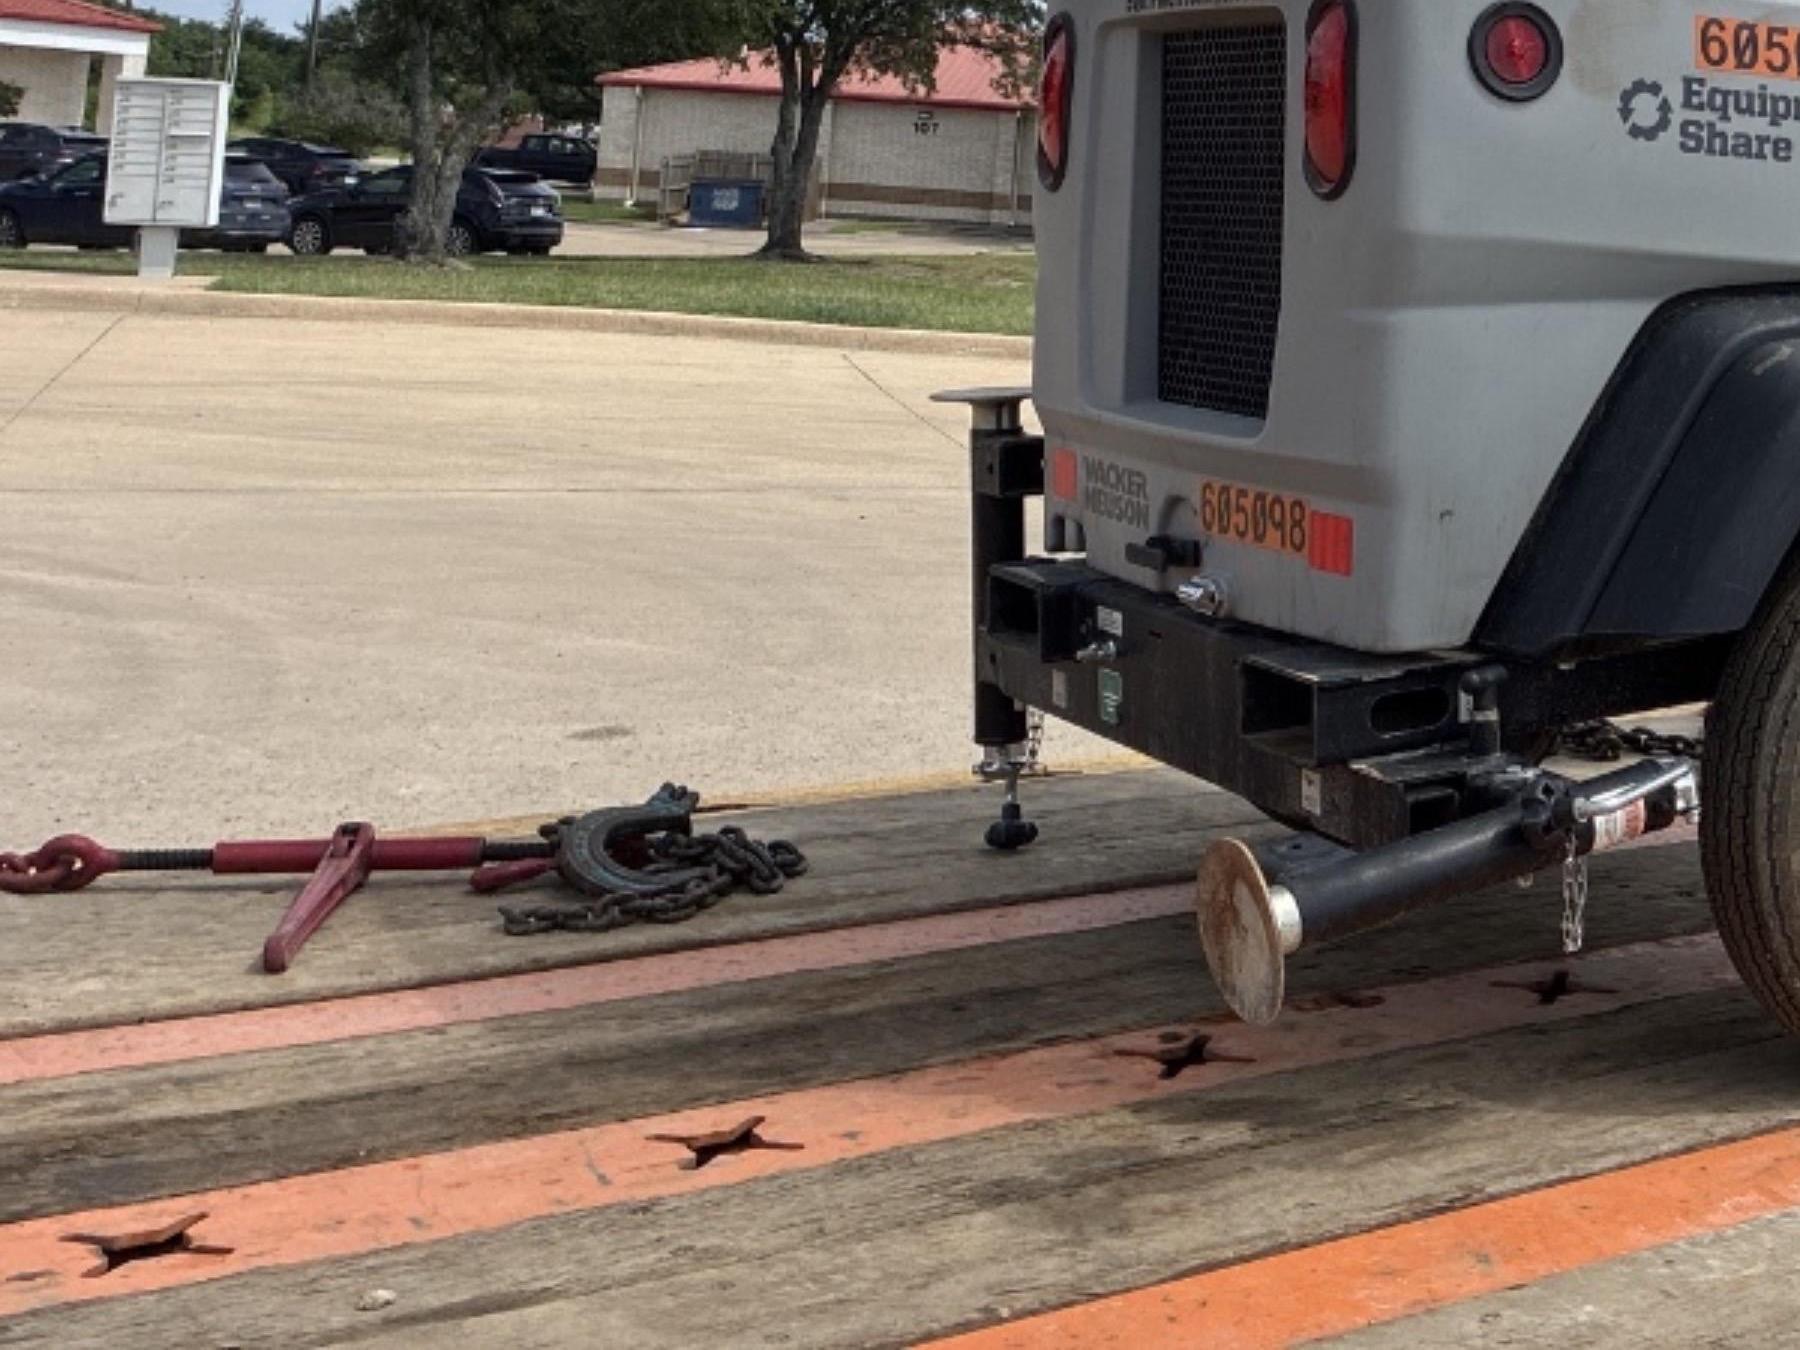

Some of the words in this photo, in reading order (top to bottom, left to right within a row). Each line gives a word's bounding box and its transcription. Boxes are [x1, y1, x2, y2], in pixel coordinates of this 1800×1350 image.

[1678, 118, 1794, 164] Share
[1082, 456, 1149, 500] WACKER
[1201, 482, 1307, 553] 605098
